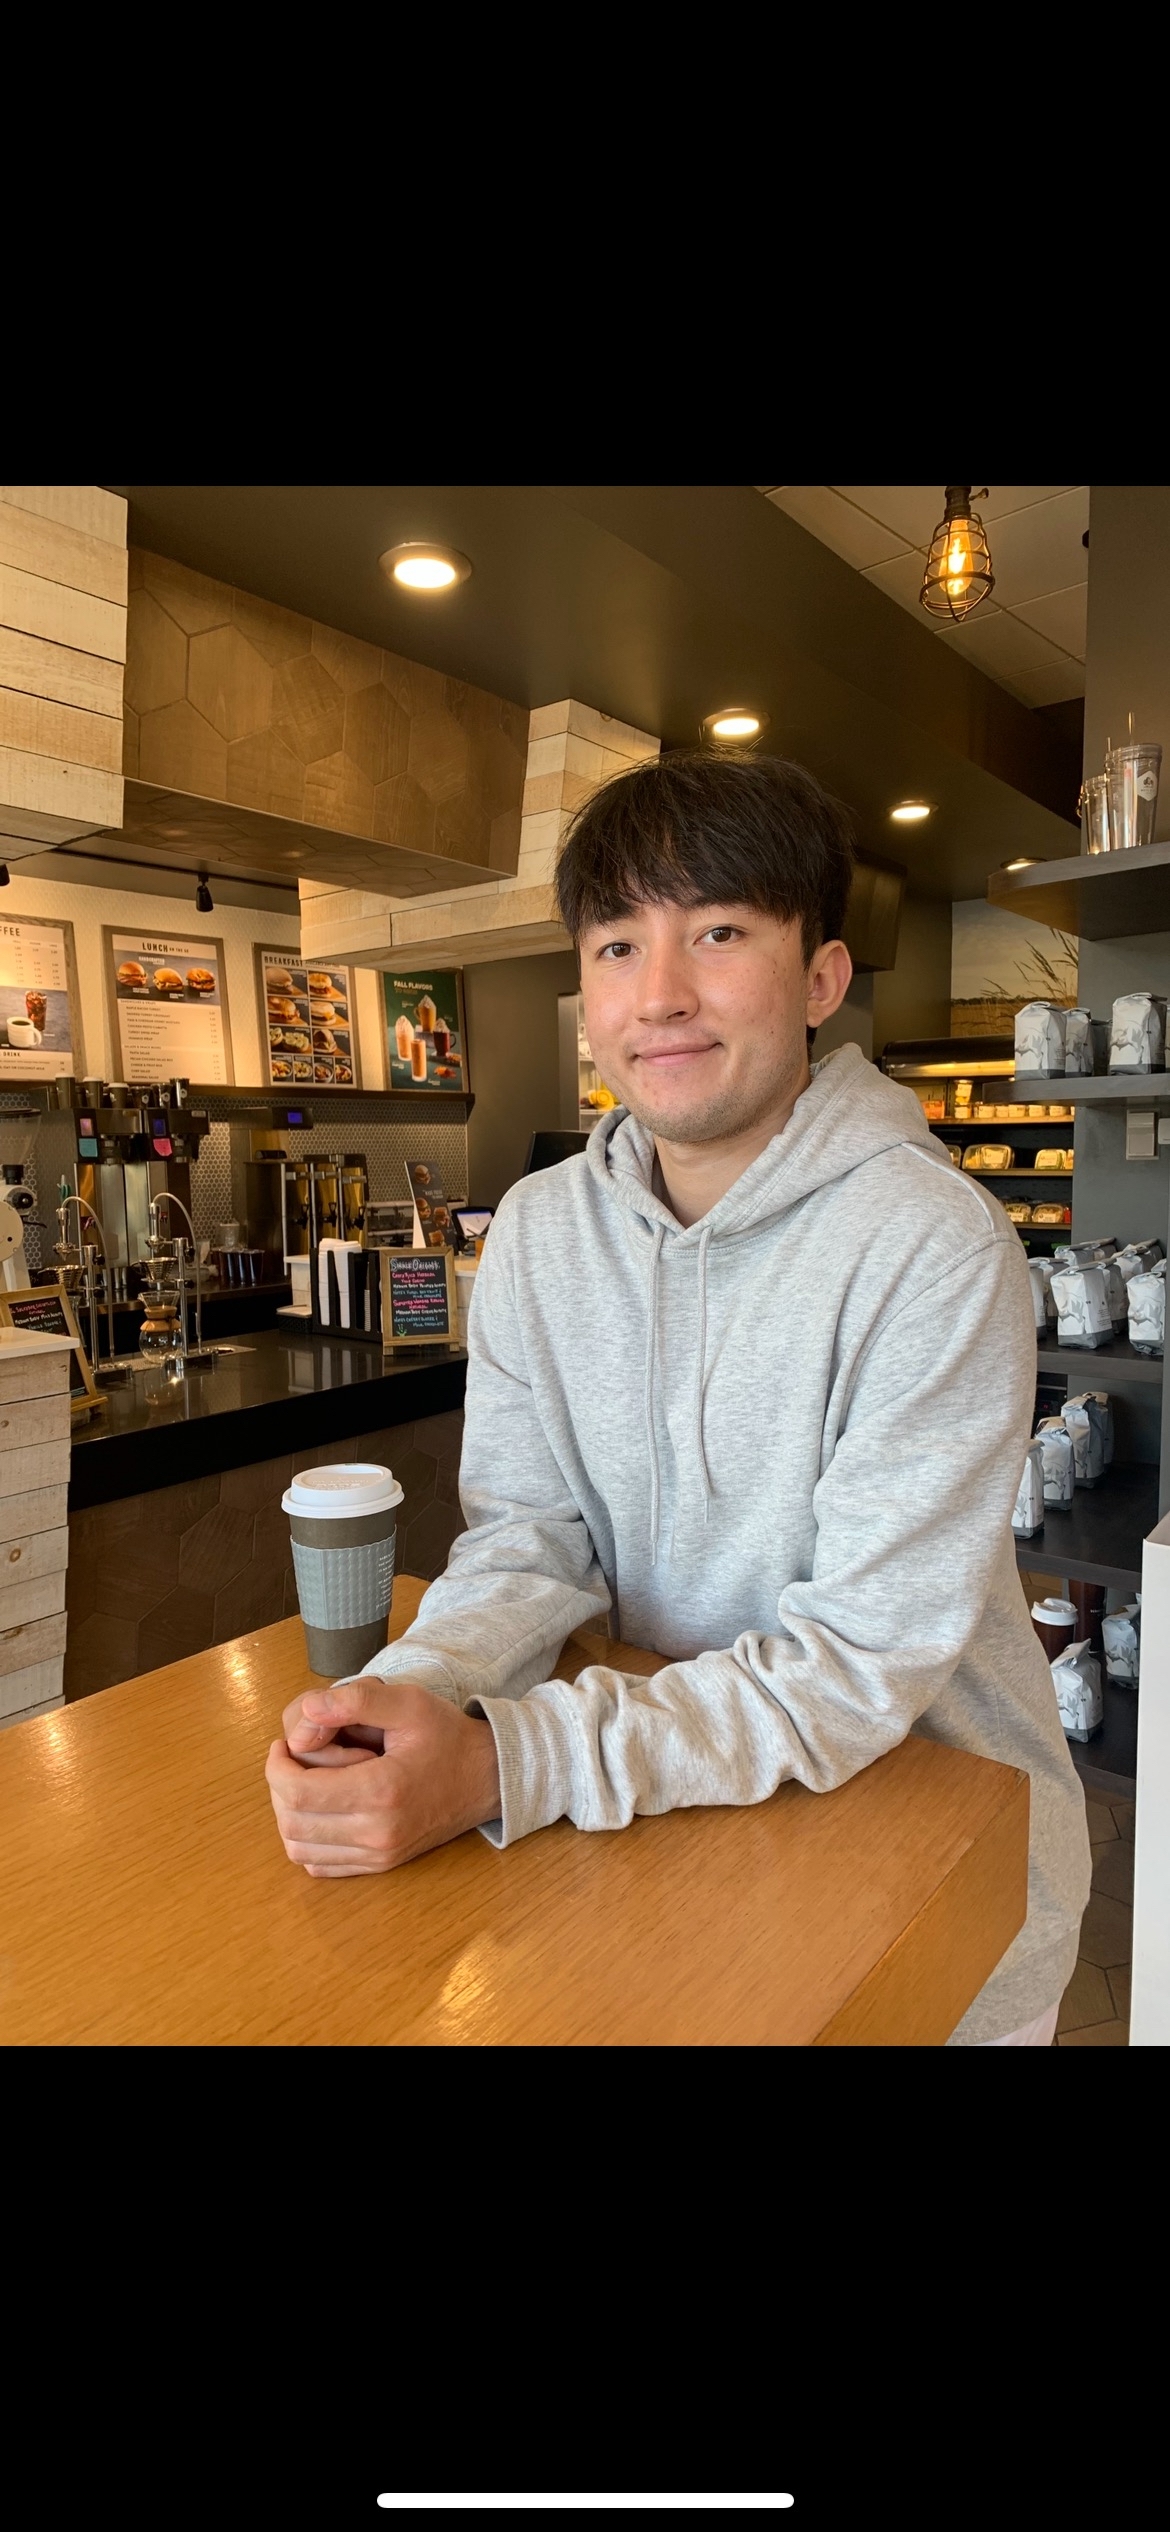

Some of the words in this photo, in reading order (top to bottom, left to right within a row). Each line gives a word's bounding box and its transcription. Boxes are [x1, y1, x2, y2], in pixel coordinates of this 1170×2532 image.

[142, 942, 168, 952] LUNCH
[264, 956, 304, 967] BREAKFAST
[394, 980, 408, 988] FALL
[408, 982, 433, 991] FLAVORS
